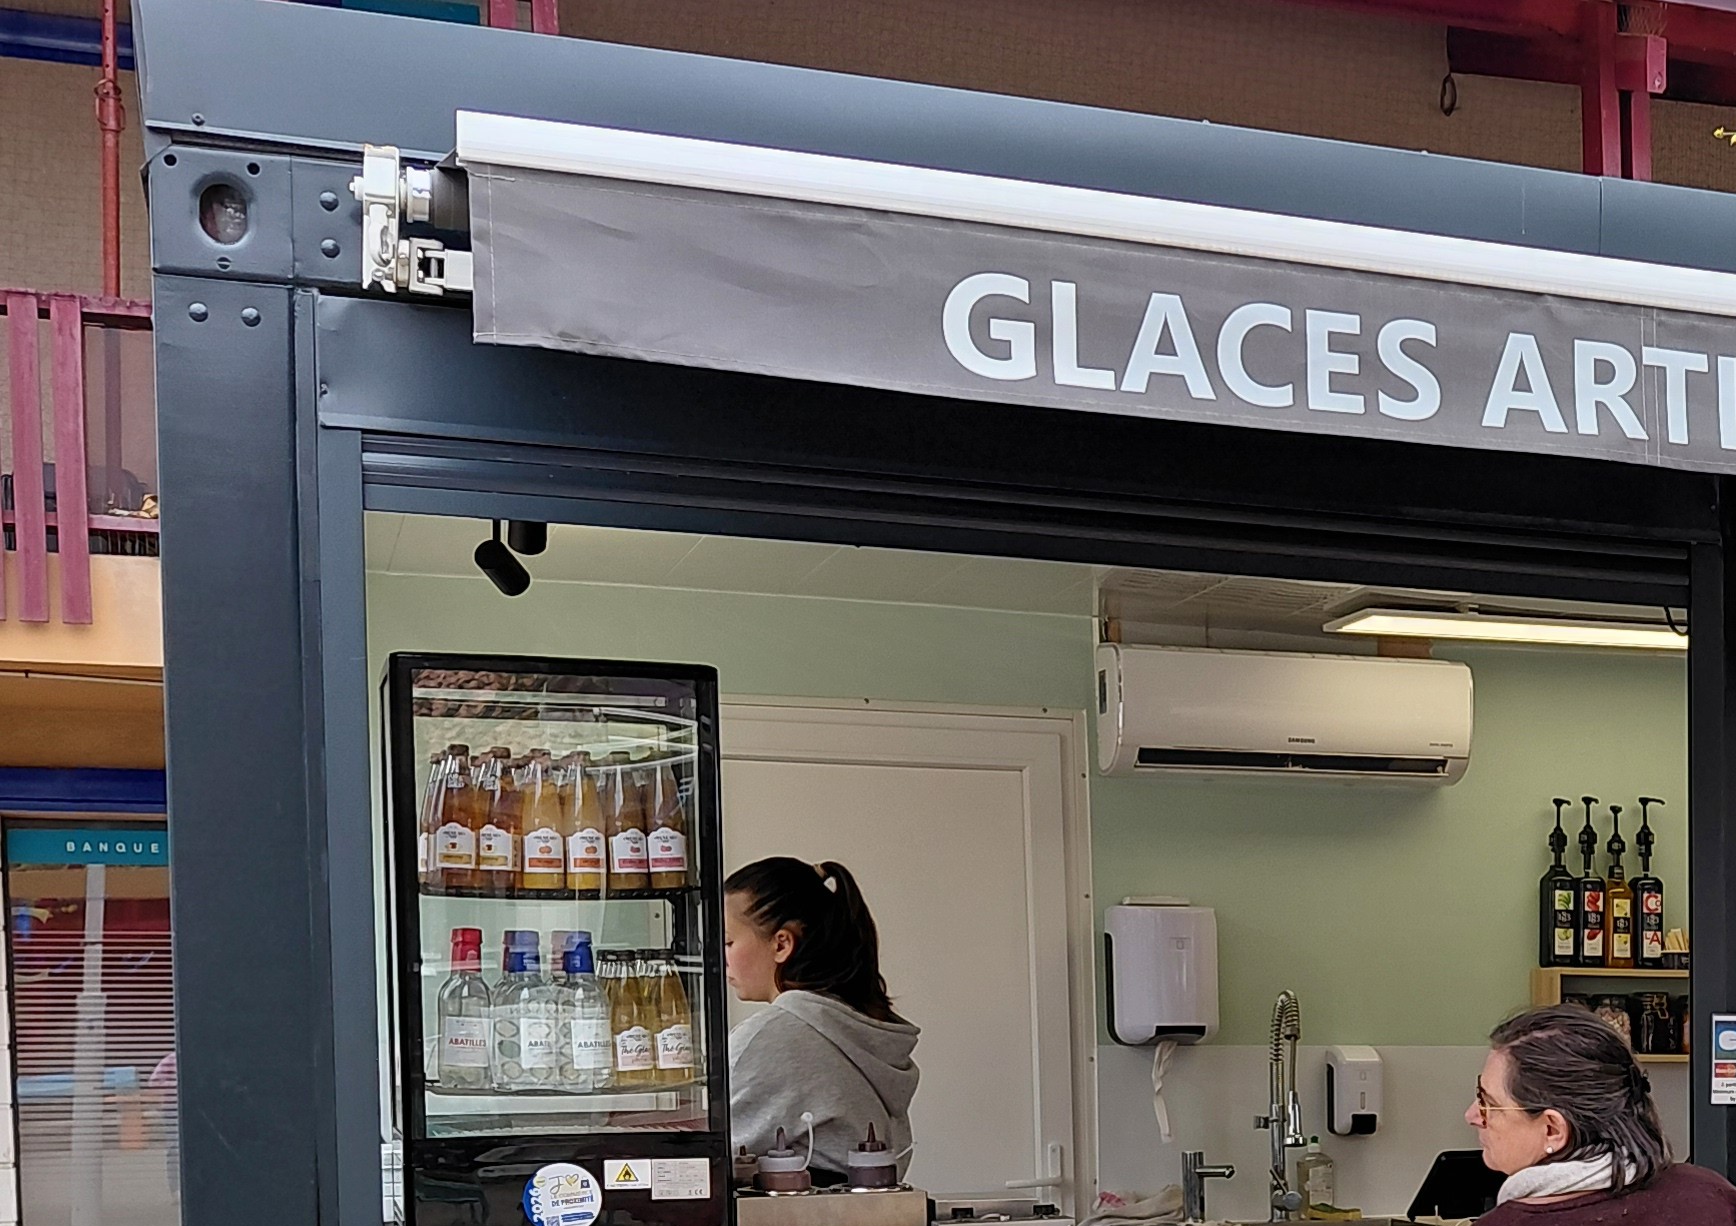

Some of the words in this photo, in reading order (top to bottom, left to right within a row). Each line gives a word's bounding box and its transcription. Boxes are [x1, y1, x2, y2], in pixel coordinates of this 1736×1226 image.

[942, 272, 1442, 420] GLACES
[66, 841, 160, 853] BANQUE
[449, 1038, 486, 1047] ABATILLES
